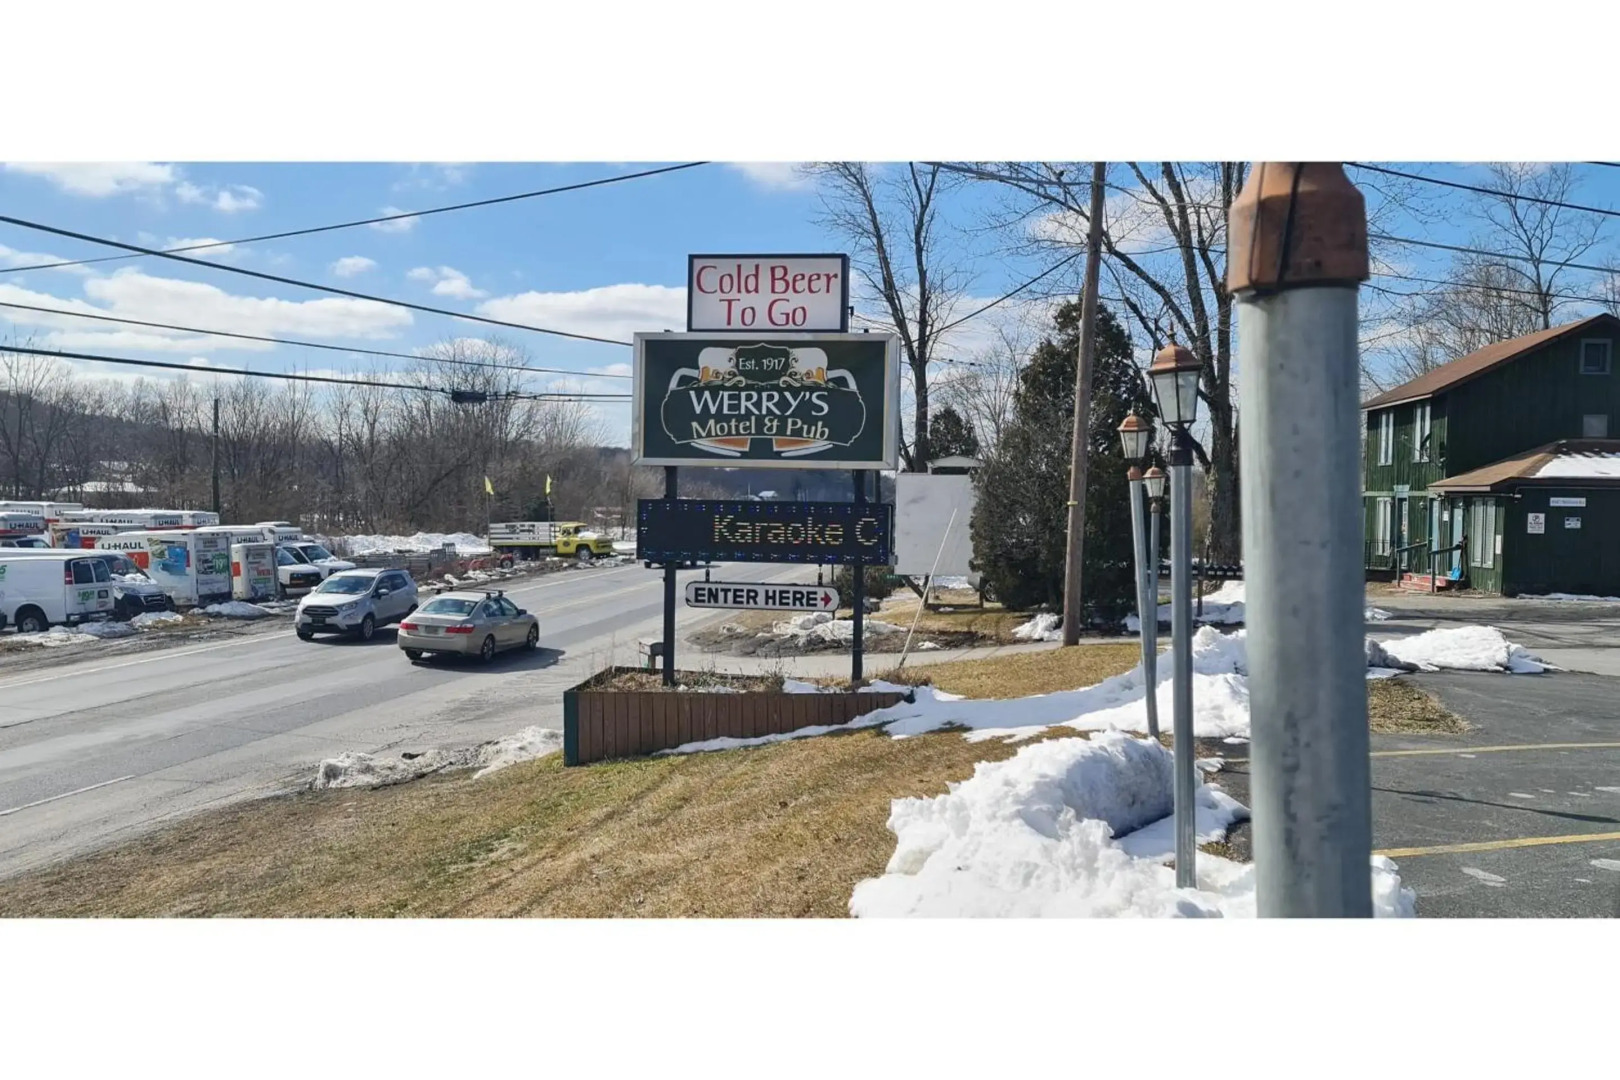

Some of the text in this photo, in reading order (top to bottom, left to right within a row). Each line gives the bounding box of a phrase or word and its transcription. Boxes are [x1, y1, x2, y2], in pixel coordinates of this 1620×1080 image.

[696, 264, 838, 294] Cold Beer
[719, 298, 807, 327] To Go
[739, 358, 785, 371] Est. 1917
[689, 390, 829, 416] WERRY'S
[691, 416, 829, 440] Motel & Pub
[713, 515, 879, 546] Karaoke C
[101, 542, 144, 550] U-HAUL
[694, 587, 818, 607] ENTER HERE
